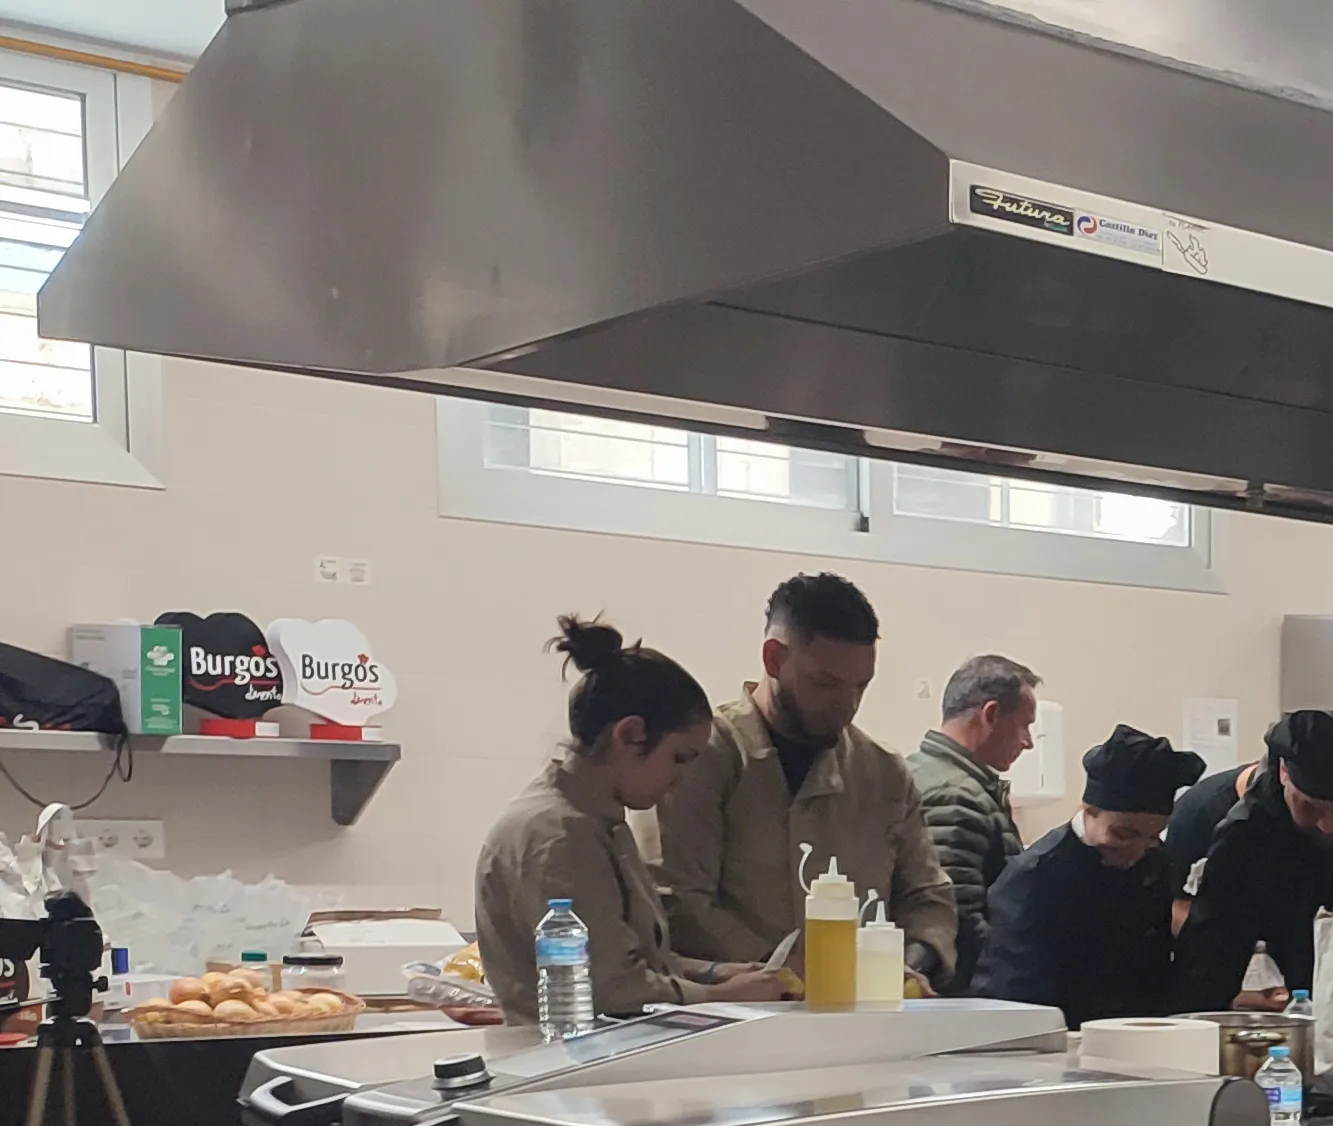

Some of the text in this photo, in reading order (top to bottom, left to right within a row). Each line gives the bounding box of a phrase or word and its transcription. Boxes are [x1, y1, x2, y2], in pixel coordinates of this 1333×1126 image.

[974, 187, 1072, 226] Futura
[190, 646, 279, 686] Burgos
[301, 653, 380, 689] Burgos
